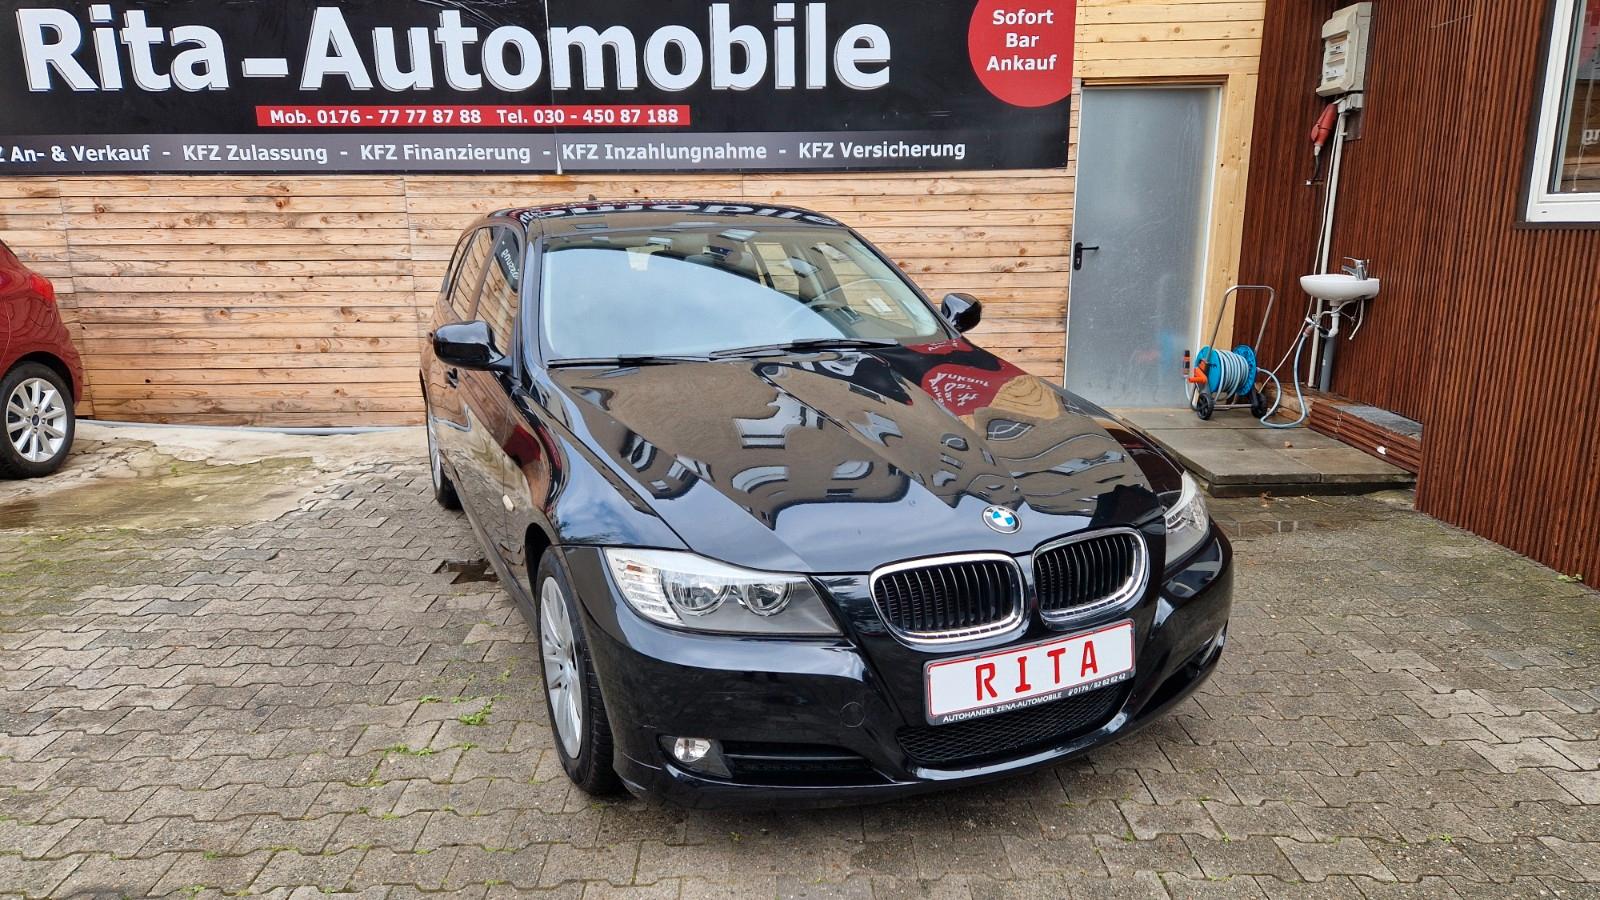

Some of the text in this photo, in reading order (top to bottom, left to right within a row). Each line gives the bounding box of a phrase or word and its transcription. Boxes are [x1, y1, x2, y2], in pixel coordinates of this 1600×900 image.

[993, 9, 1054, 25] Sofort
[1006, 33, 1040, 48] Bar
[986, 55, 1057, 71] Ankauf
[270, 109, 312, 124] Mob.
[317, 109, 361, 124] 0176
[379, 109, 400, 124] 77
[405, 109, 427, 124] 77
[432, 109, 454, 124] 87
[459, 109, 482, 124] 88
[496, 109, 528, 124] Tel.
[533, 109, 565, 124] 030
[582, 109, 615, 124] 450
[620, 109, 641, 124] 87
[647, 109, 679, 124] 188
[11, 146, 45, 162] An-
[51, 145, 68, 162] &
[71, 145, 150, 161] Verkauf
[183, 145, 222, 161] KFZ
[226, 144, 328, 165] Zulassung
[360, 144, 398, 161] KFZ
[403, 143, 531, 165] Finanzierung
[562, 143, 599, 160] KFZ
[605, 142, 767, 164] Inzahlungnahme
[800, 142, 834, 159] KFZ
[840, 140, 966, 160] Versicherung
[942, 708, 995, 723] AUTOHANDEL
